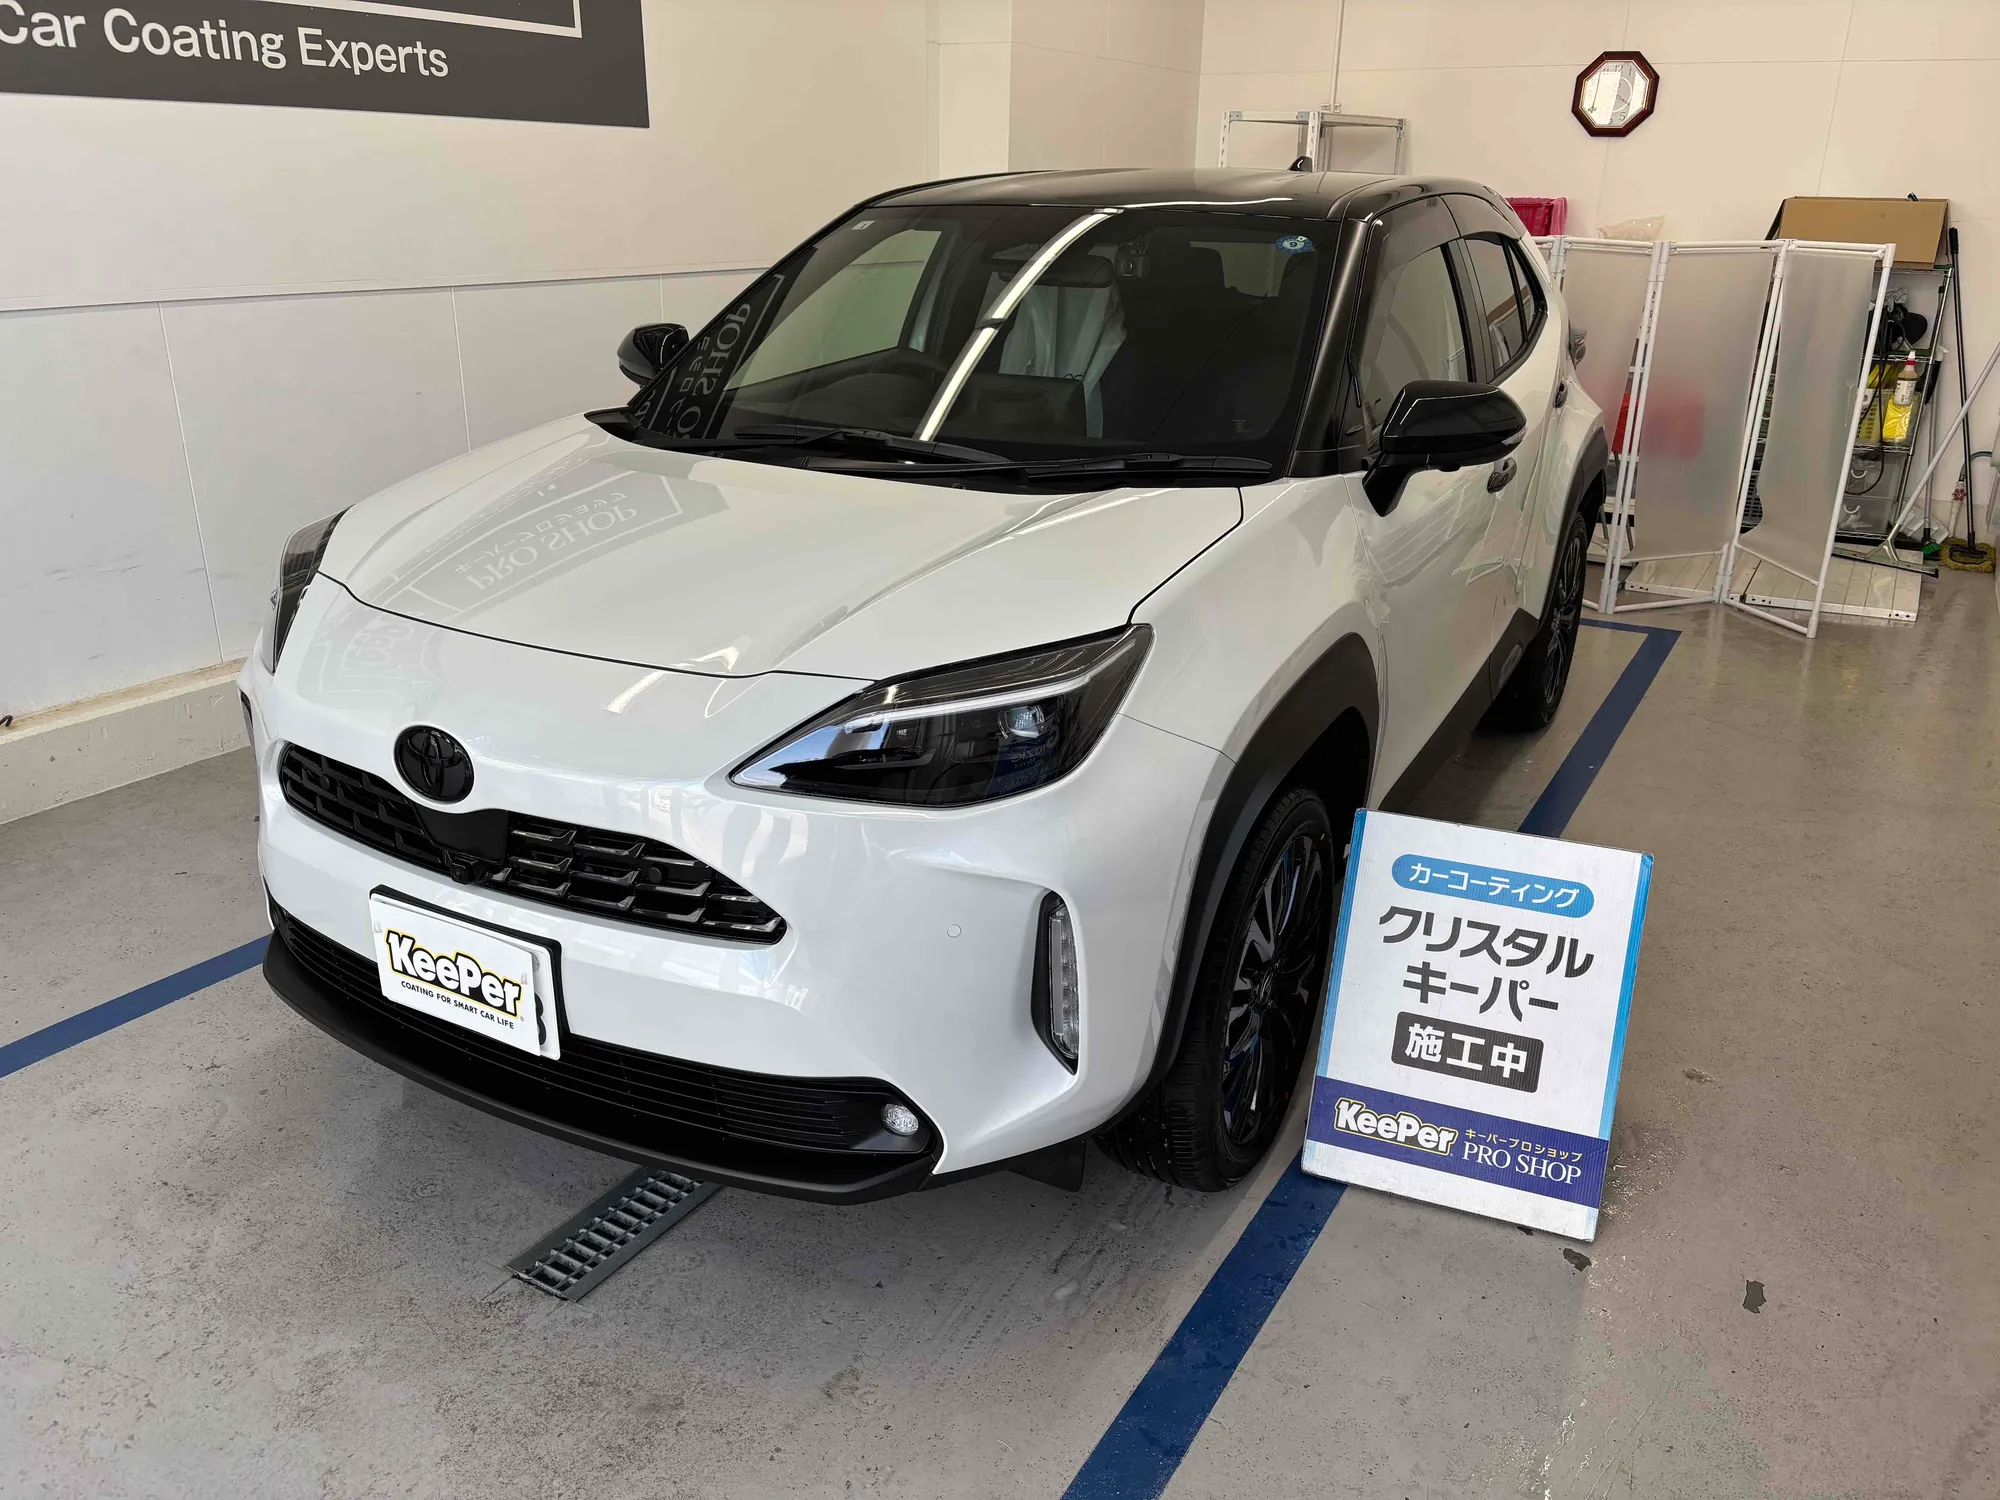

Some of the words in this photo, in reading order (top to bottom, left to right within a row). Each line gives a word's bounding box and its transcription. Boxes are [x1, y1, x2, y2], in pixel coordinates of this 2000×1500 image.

[0, 0, 86, 48] Car
[103, 8, 287, 69] Coating
[297, 26, 449, 77] Experts
[1409, 863, 1580, 908] カーコーティング
[1379, 905, 1594, 978] クリスタル
[386, 930, 522, 1017] KeePer
[1403, 961, 1559, 1022] キーパー
[401, 981, 434, 998] COATING
[436, 993, 452, 1005] FOR
[454, 999, 478, 1015] SMART
[480, 1010, 495, 1022] CAR
[497, 1017, 515, 1030] LIFE
[1405, 1023, 1528, 1079] 施工中
[1335, 1098, 1458, 1155] KeePer
[1464, 1128, 1583, 1162] キーパープロショップ
[1462, 1141, 1511, 1169] PRO
[1515, 1154, 1582, 1185] SHOP
